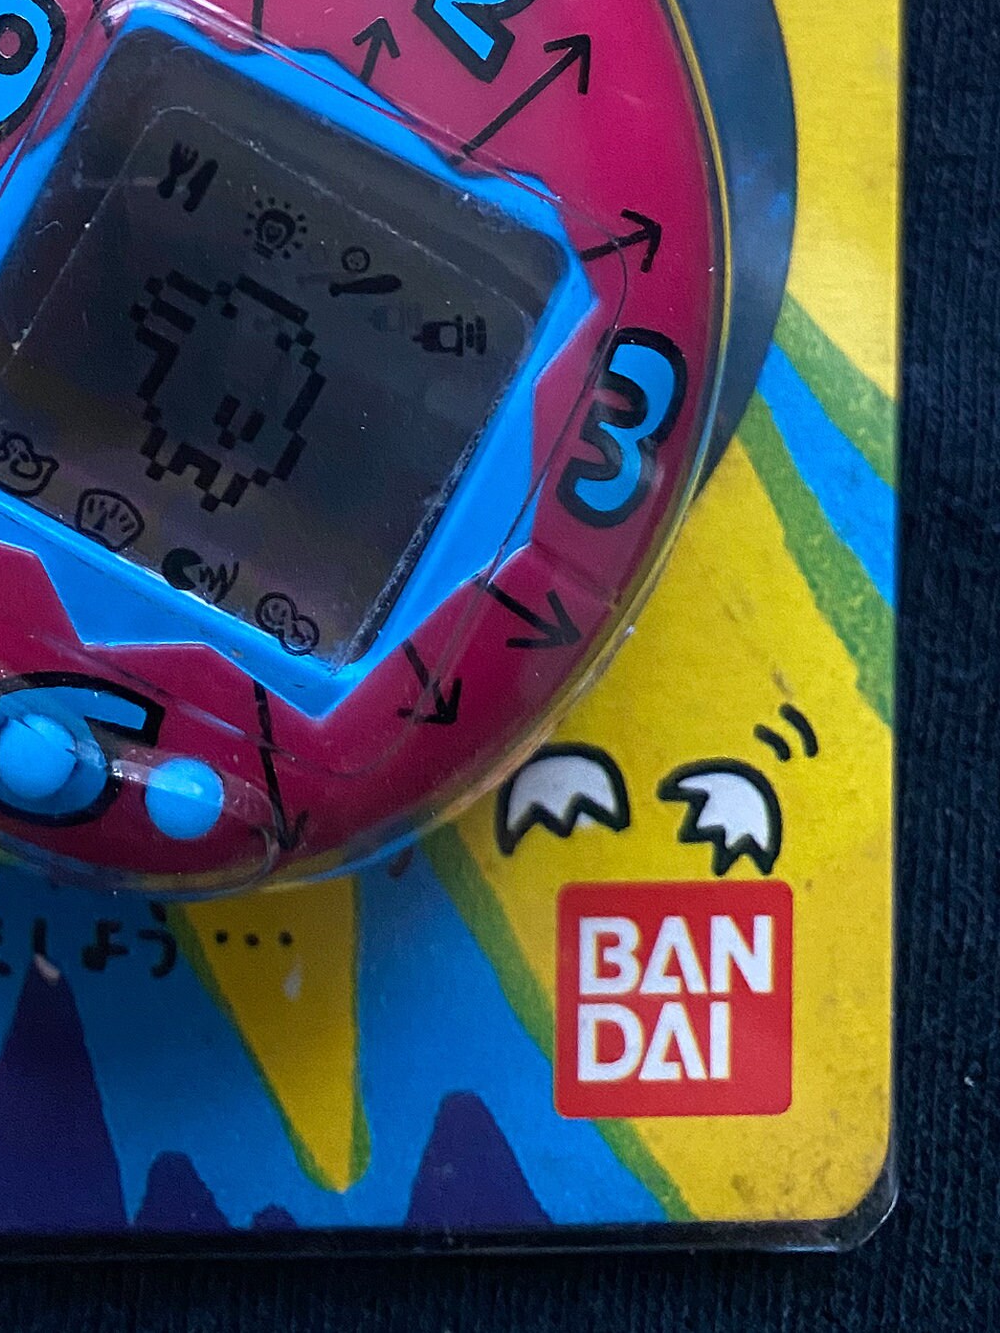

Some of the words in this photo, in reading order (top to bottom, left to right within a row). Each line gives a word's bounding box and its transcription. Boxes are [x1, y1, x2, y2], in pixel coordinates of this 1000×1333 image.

[557, 327, 687, 528] 3
[578, 915, 774, 995] BAN
[576, 1001, 732, 1083] DAI
